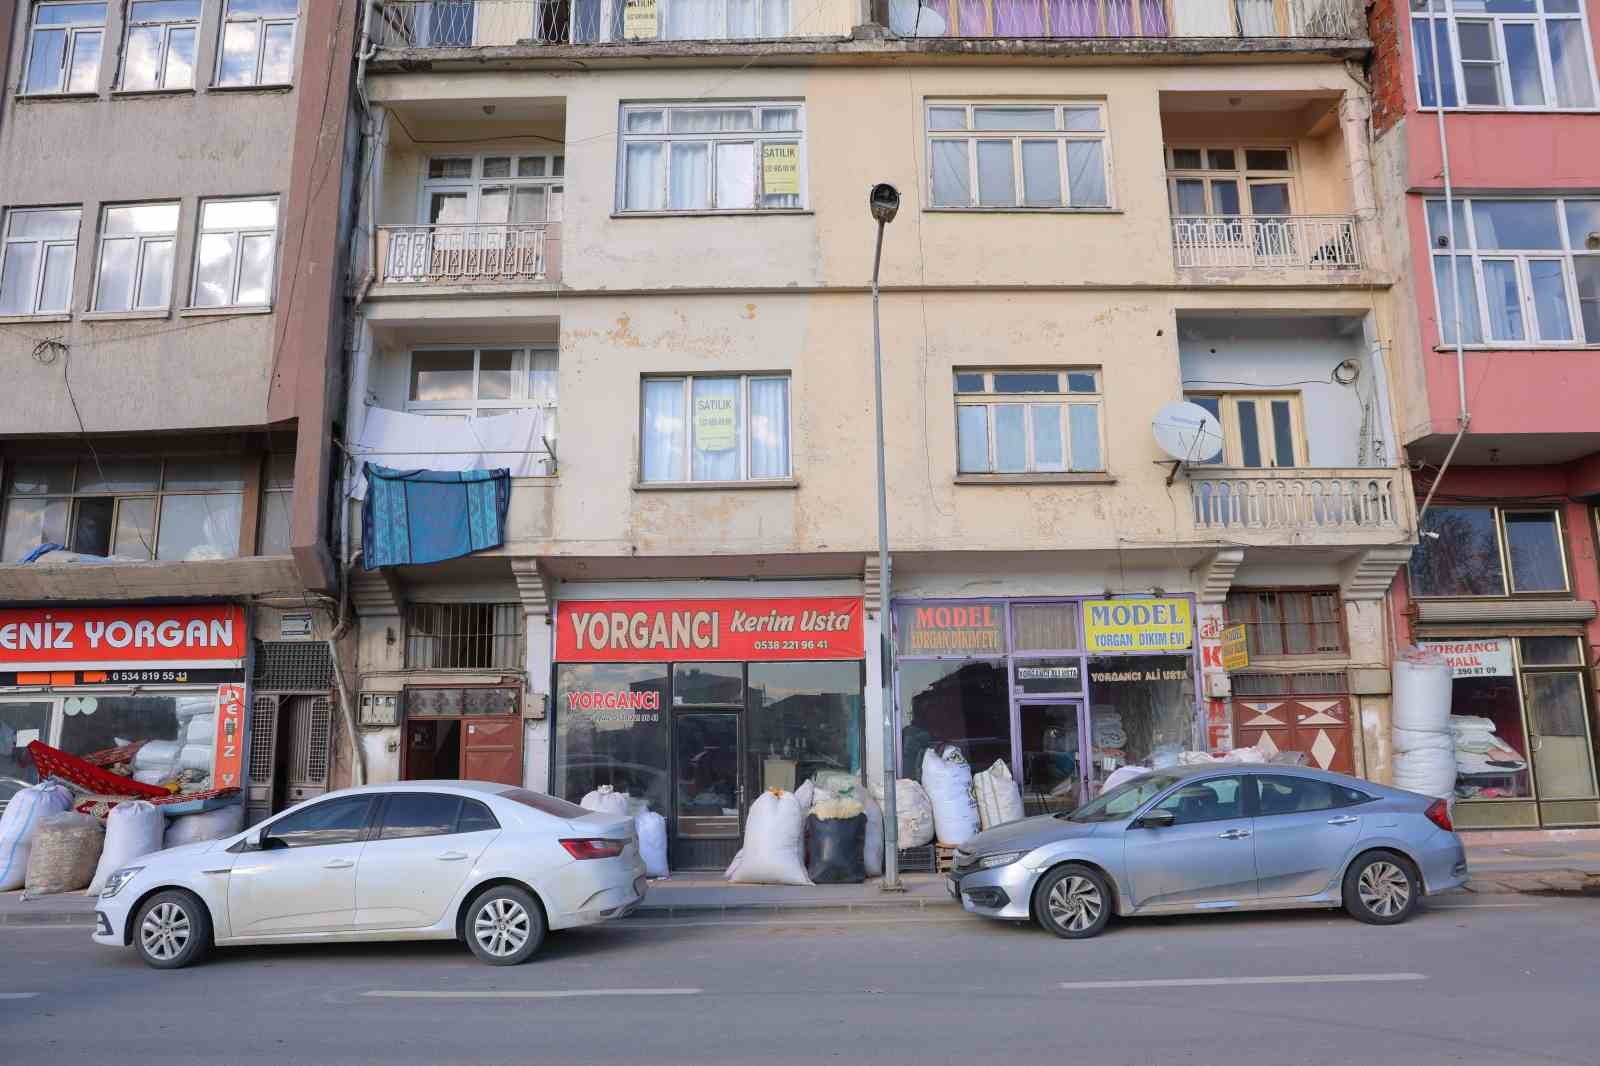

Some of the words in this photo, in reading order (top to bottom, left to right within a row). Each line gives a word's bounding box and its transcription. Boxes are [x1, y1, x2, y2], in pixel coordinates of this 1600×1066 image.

[764, 147, 796, 158] SATILIK
[697, 399, 733, 410] SATILIK
[730, 609, 796, 632] Kerim
[800, 610, 851, 632] Usta
[916, 606, 993, 628] MODEL
[1091, 604, 1185, 627] MODEL
[84, 619, 234, 649] YORGAN
[570, 611, 720, 650] YORGANCI
[1095, 632, 1133, 647] YORGAN
[121, 672, 139, 681] 534
[141, 672, 160, 680] 819
[162, 671, 175, 680] 55
[567, 690, 660, 711] YORGANCI
